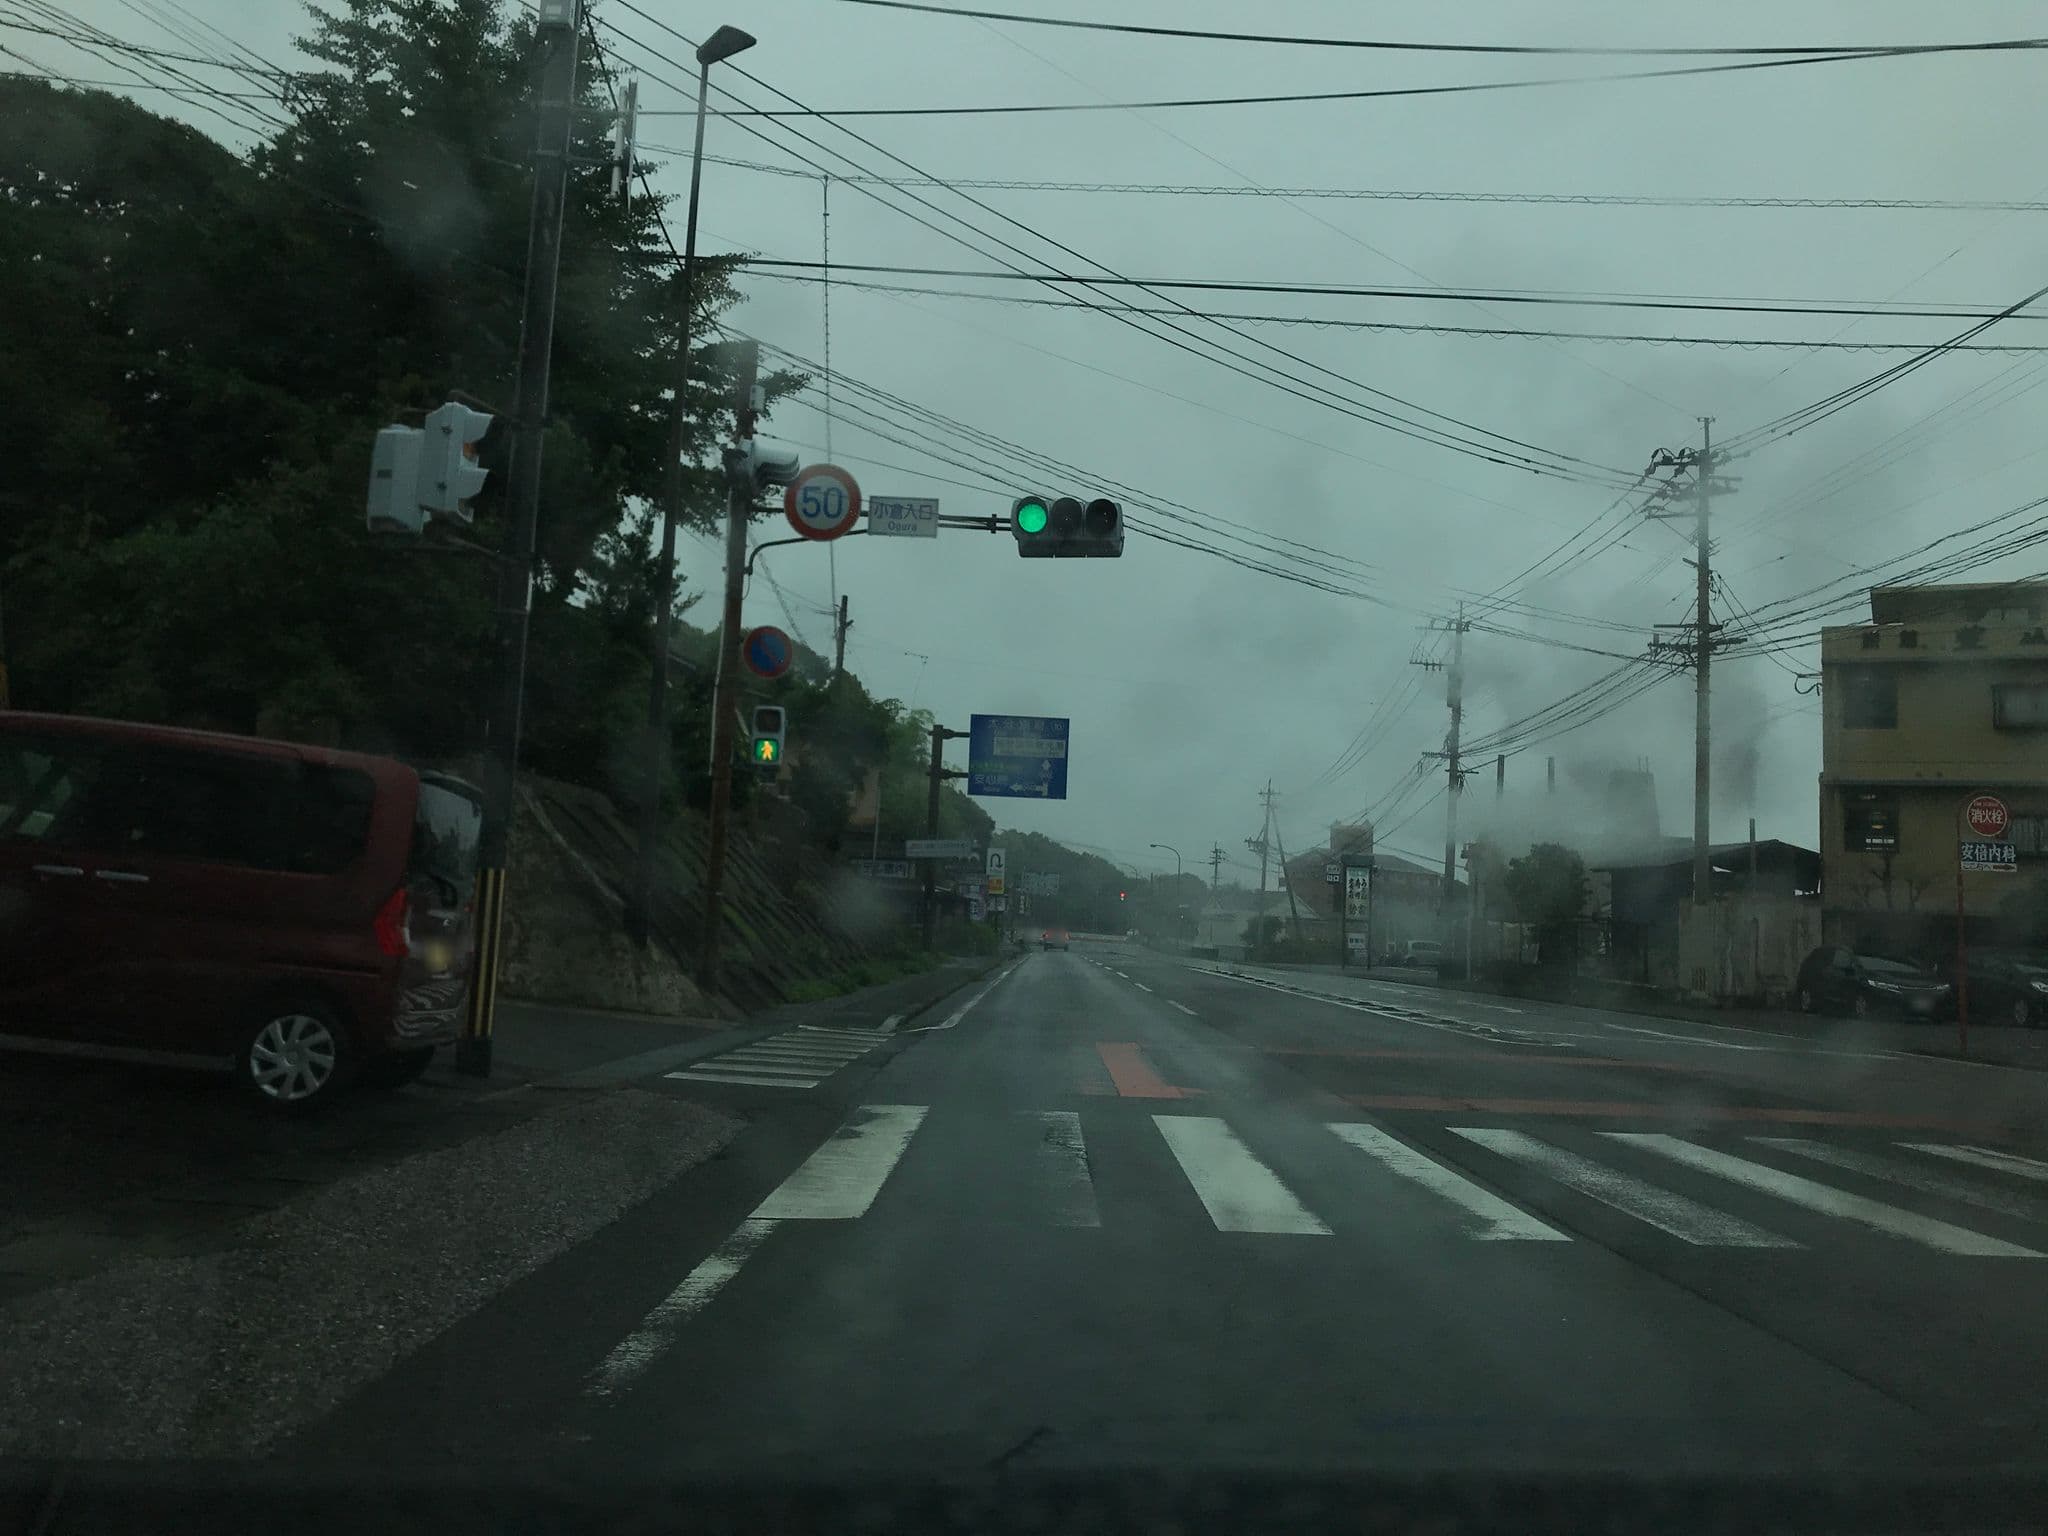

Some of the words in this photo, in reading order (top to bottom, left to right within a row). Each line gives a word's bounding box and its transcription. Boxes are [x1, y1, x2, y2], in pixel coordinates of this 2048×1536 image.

[802, 486, 842, 518] 50
[1970, 808, 2004, 824] 消火栓
[1961, 842, 2017, 863] 安倍内科
